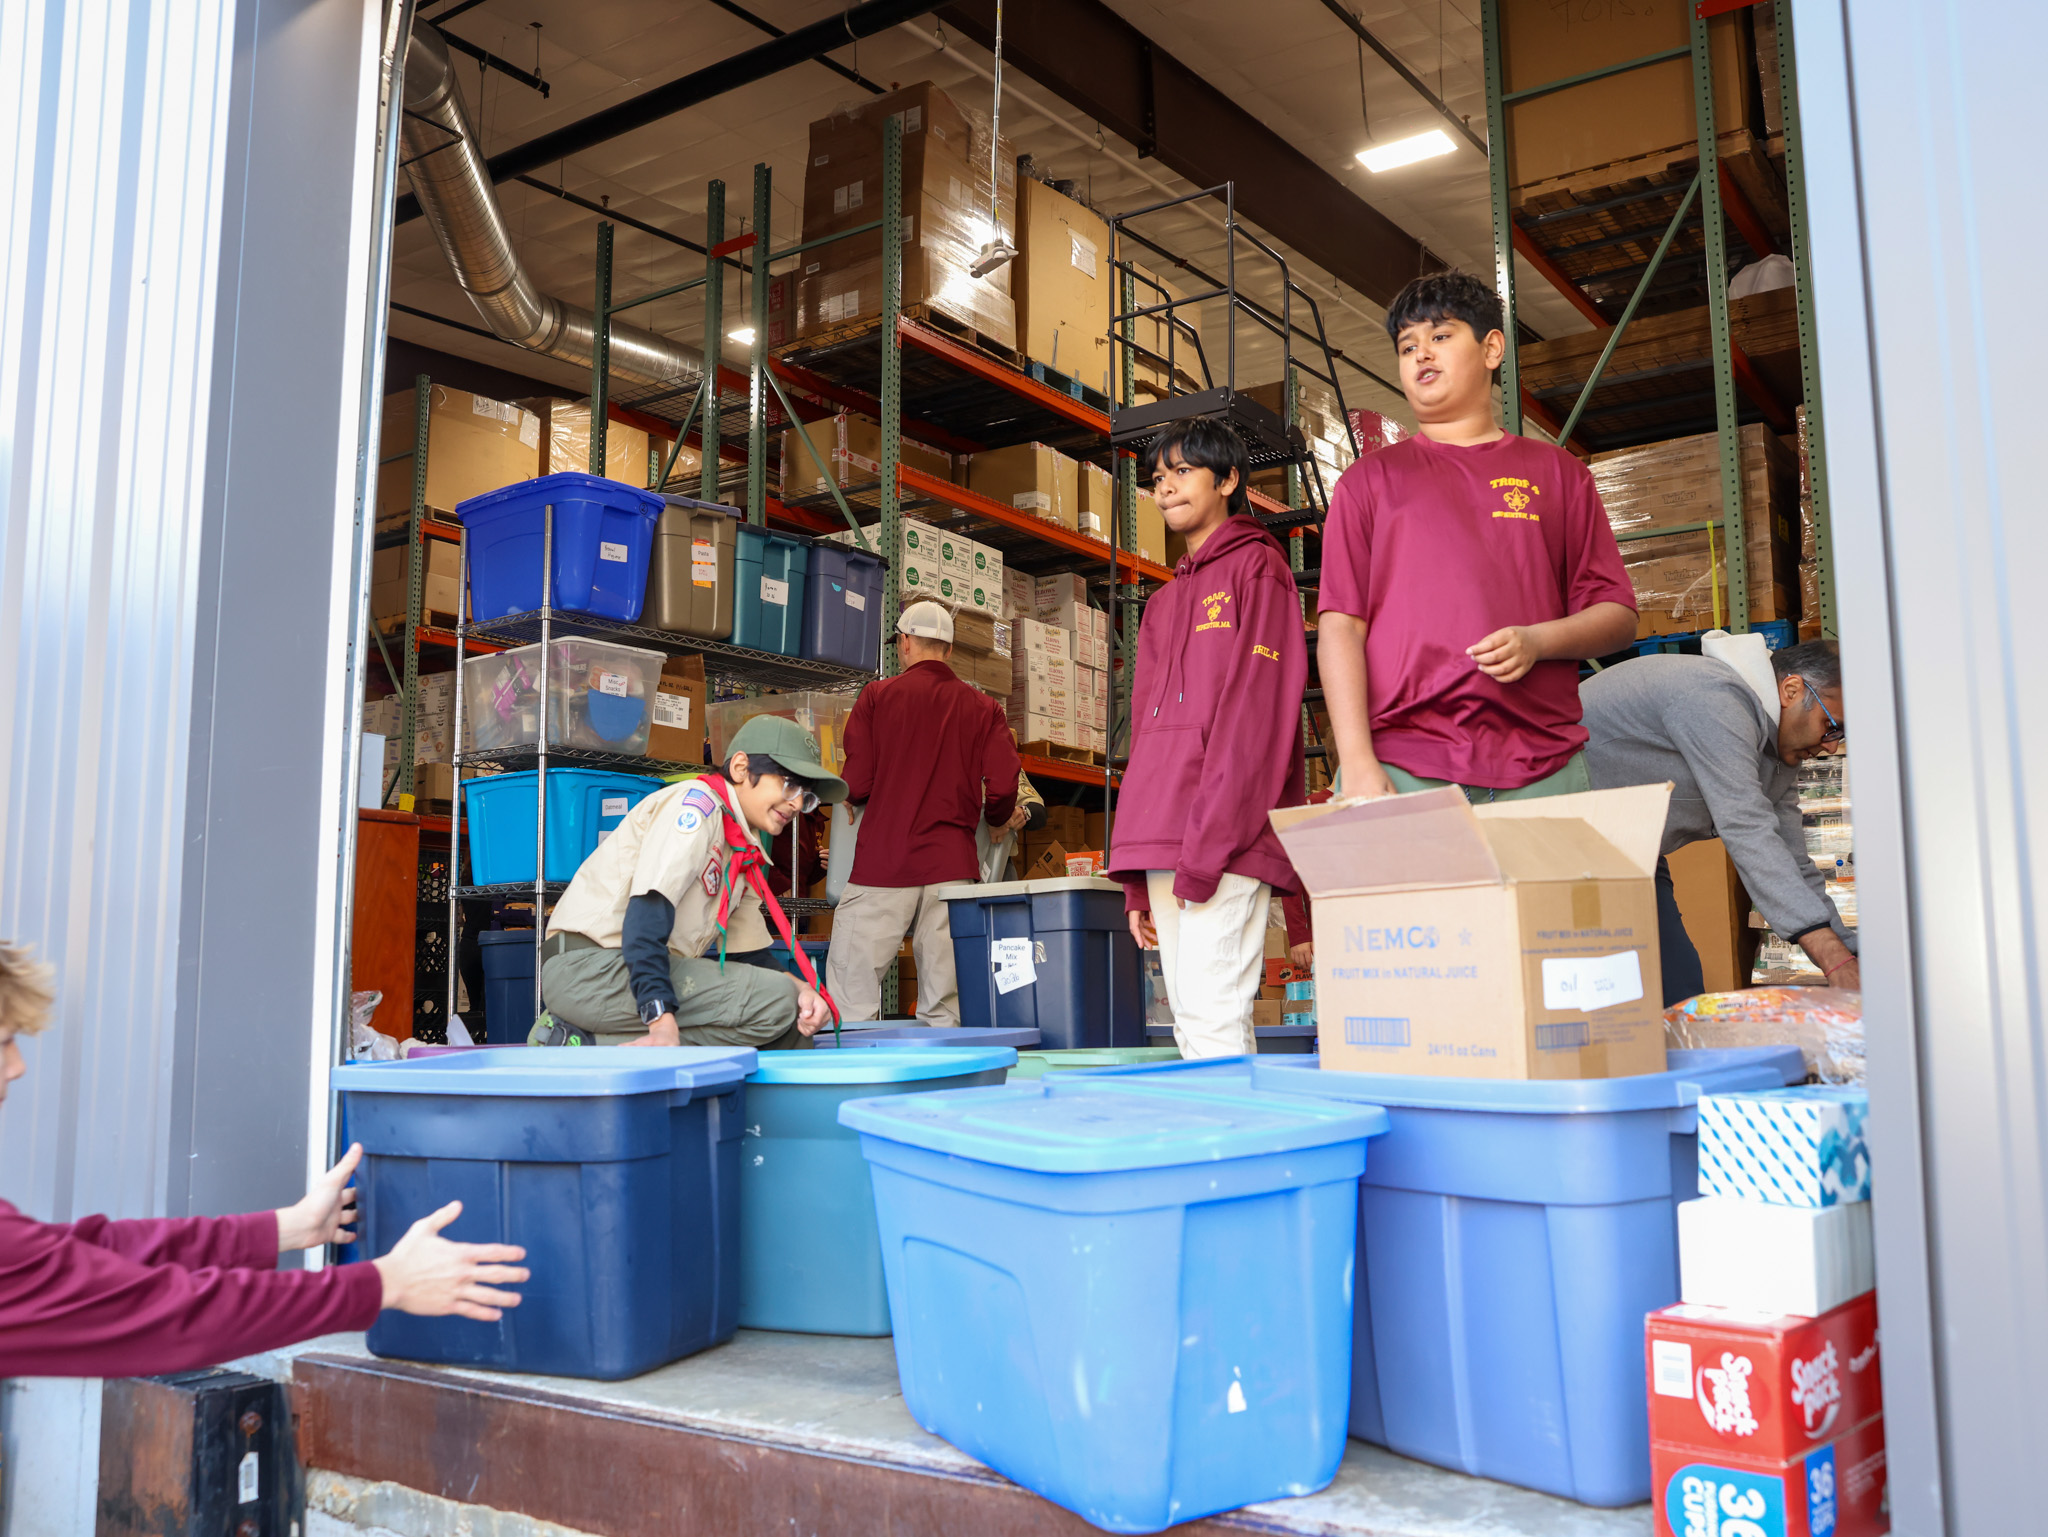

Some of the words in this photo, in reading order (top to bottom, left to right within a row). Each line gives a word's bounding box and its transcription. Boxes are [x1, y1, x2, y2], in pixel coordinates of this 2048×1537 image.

[1490, 477, 1530, 489] TROOP
[1662, 491, 1696, 504] Twizzlers
[1202, 591, 1226, 607] TROOP
[1344, 925, 1440, 952] NEMCO
[998, 943, 1026, 951] Pancake
[1332, 968, 1360, 979] FRUIT
[1363, 968, 1379, 979] MIX
[1383, 968, 1392, 978] in
[1394, 967, 1442, 979] NATURAL
[1445, 966, 1478, 979] JUICE
[1427, 1043, 1455, 1056] 24/15
[1457, 1046, 1468, 1056] oz
[1471, 1044, 1497, 1057] Cans
[1791, 1340, 1838, 1405] Snack
[1704, 1368, 1733, 1434] Pack
[1720, 1352, 1759, 1436] Snack
[1809, 1461, 1835, 1504] 36
